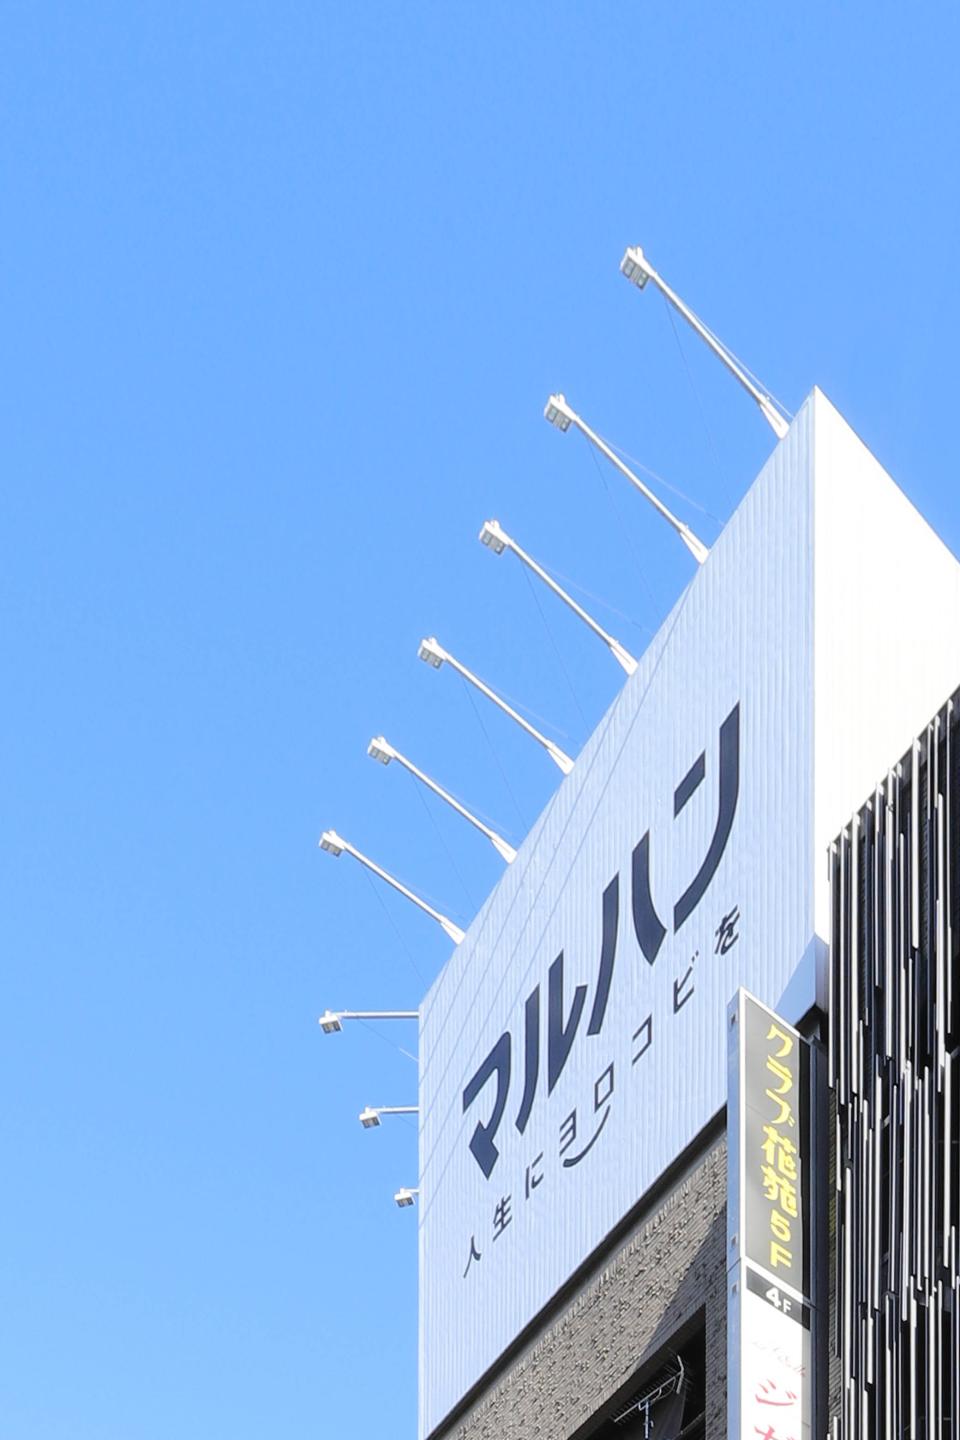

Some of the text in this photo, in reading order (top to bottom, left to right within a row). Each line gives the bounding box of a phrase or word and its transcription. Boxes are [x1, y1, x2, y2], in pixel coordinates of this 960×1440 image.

[461, 699, 740, 1180] マルハン
[461, 903, 740, 1280] 人生にヨロコビを
[765, 1285, 793, 1314] 4F
